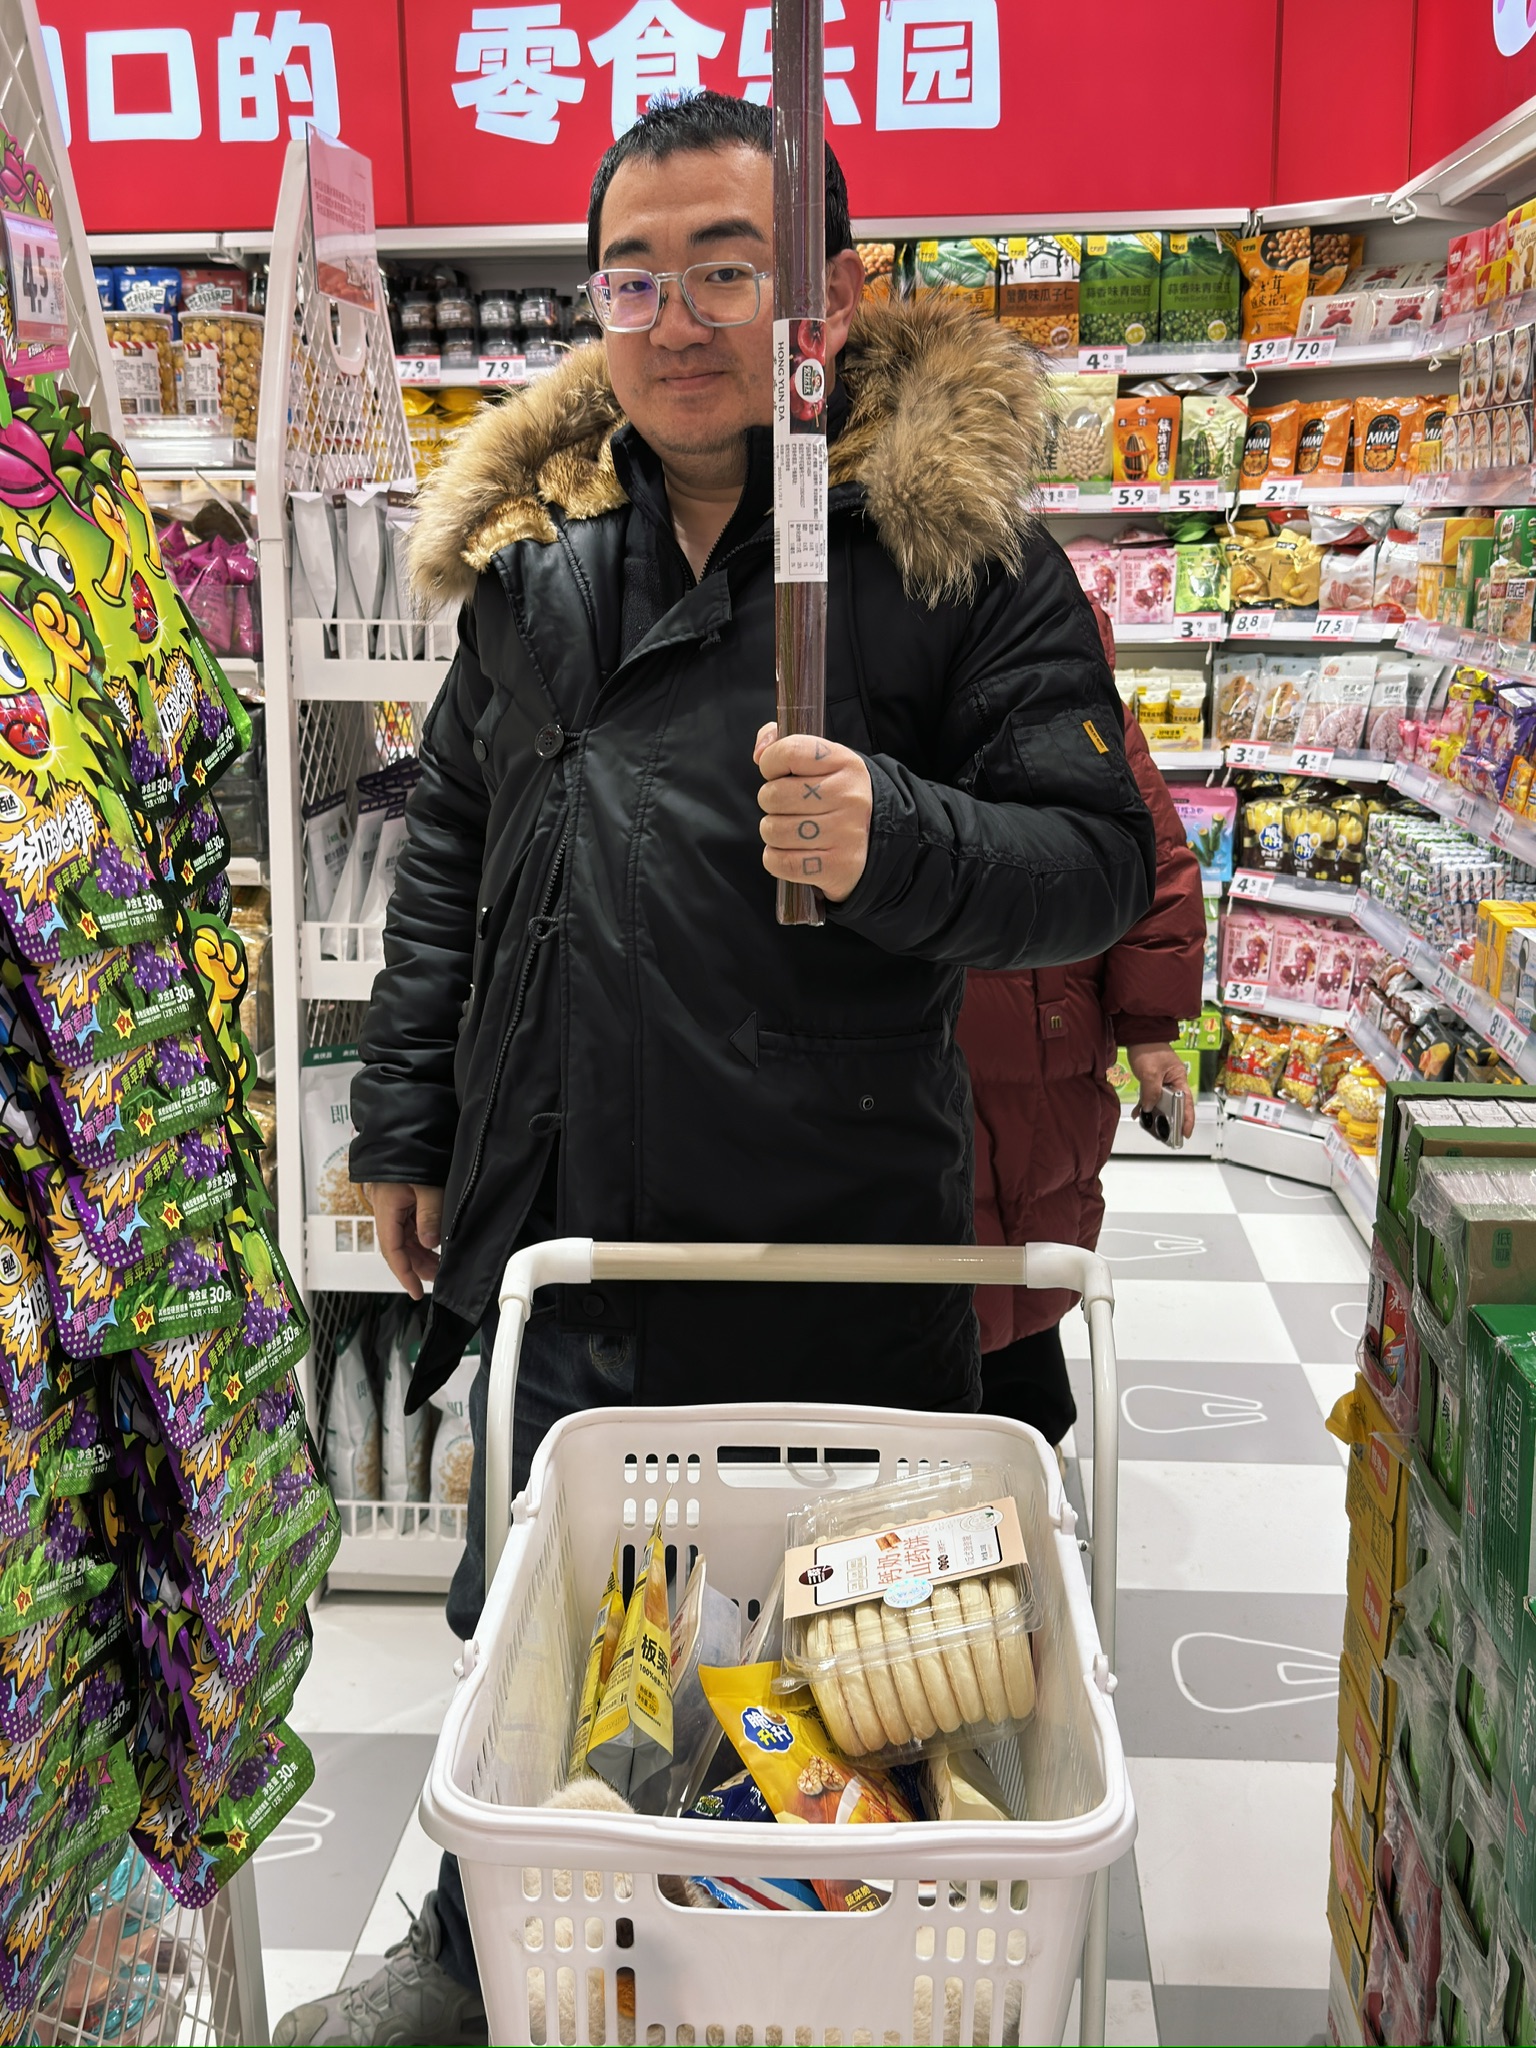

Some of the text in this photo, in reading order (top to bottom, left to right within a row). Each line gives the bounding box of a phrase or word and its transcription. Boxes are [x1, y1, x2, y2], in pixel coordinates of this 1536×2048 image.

[42, 0, 1001, 147] 口的 零食乐园
[485, 361, 510, 378] 7.9
[1250, 341, 1275, 360] 3.9
[1297, 342, 1320, 359] 7.0
[777, 341, 785, 422] HONG YUN DA
[1118, 489, 1144, 506] 5.9
[1236, 615, 1259, 632] 8.8
[1316, 619, 1342, 635] 17.5
[54, 855, 90, 895] 青苹果味
[25, 901, 54, 938] 葡萄味
[125, 893, 165, 912] 净含量30克
[97, 954, 129, 996] 青苹果味
[157, 984, 196, 1003] 净含量30克
[1229, 983, 1252, 1000] 3.9
[61, 1003, 93, 1044] 葡萄味
[121, 1051, 153, 1094] 青苹果味
[180, 1078, 218, 1098] 净含量30克
[81, 1103, 117, 1144] 葡萄味
[144, 1147, 178, 1191] 青苹果味
[104, 1202, 136, 1245] 葡萄味
[123, 1250, 165, 1289] 青苹果味
[187, 1285, 232, 1305] 净含量30克
[189, 1304, 222, 1319] (2克×15包)
[71, 1296, 111, 1335] 葡萄味
[39, 1411, 72, 1454] 青苹果味
[641, 1633, 673, 1690] 板栗
